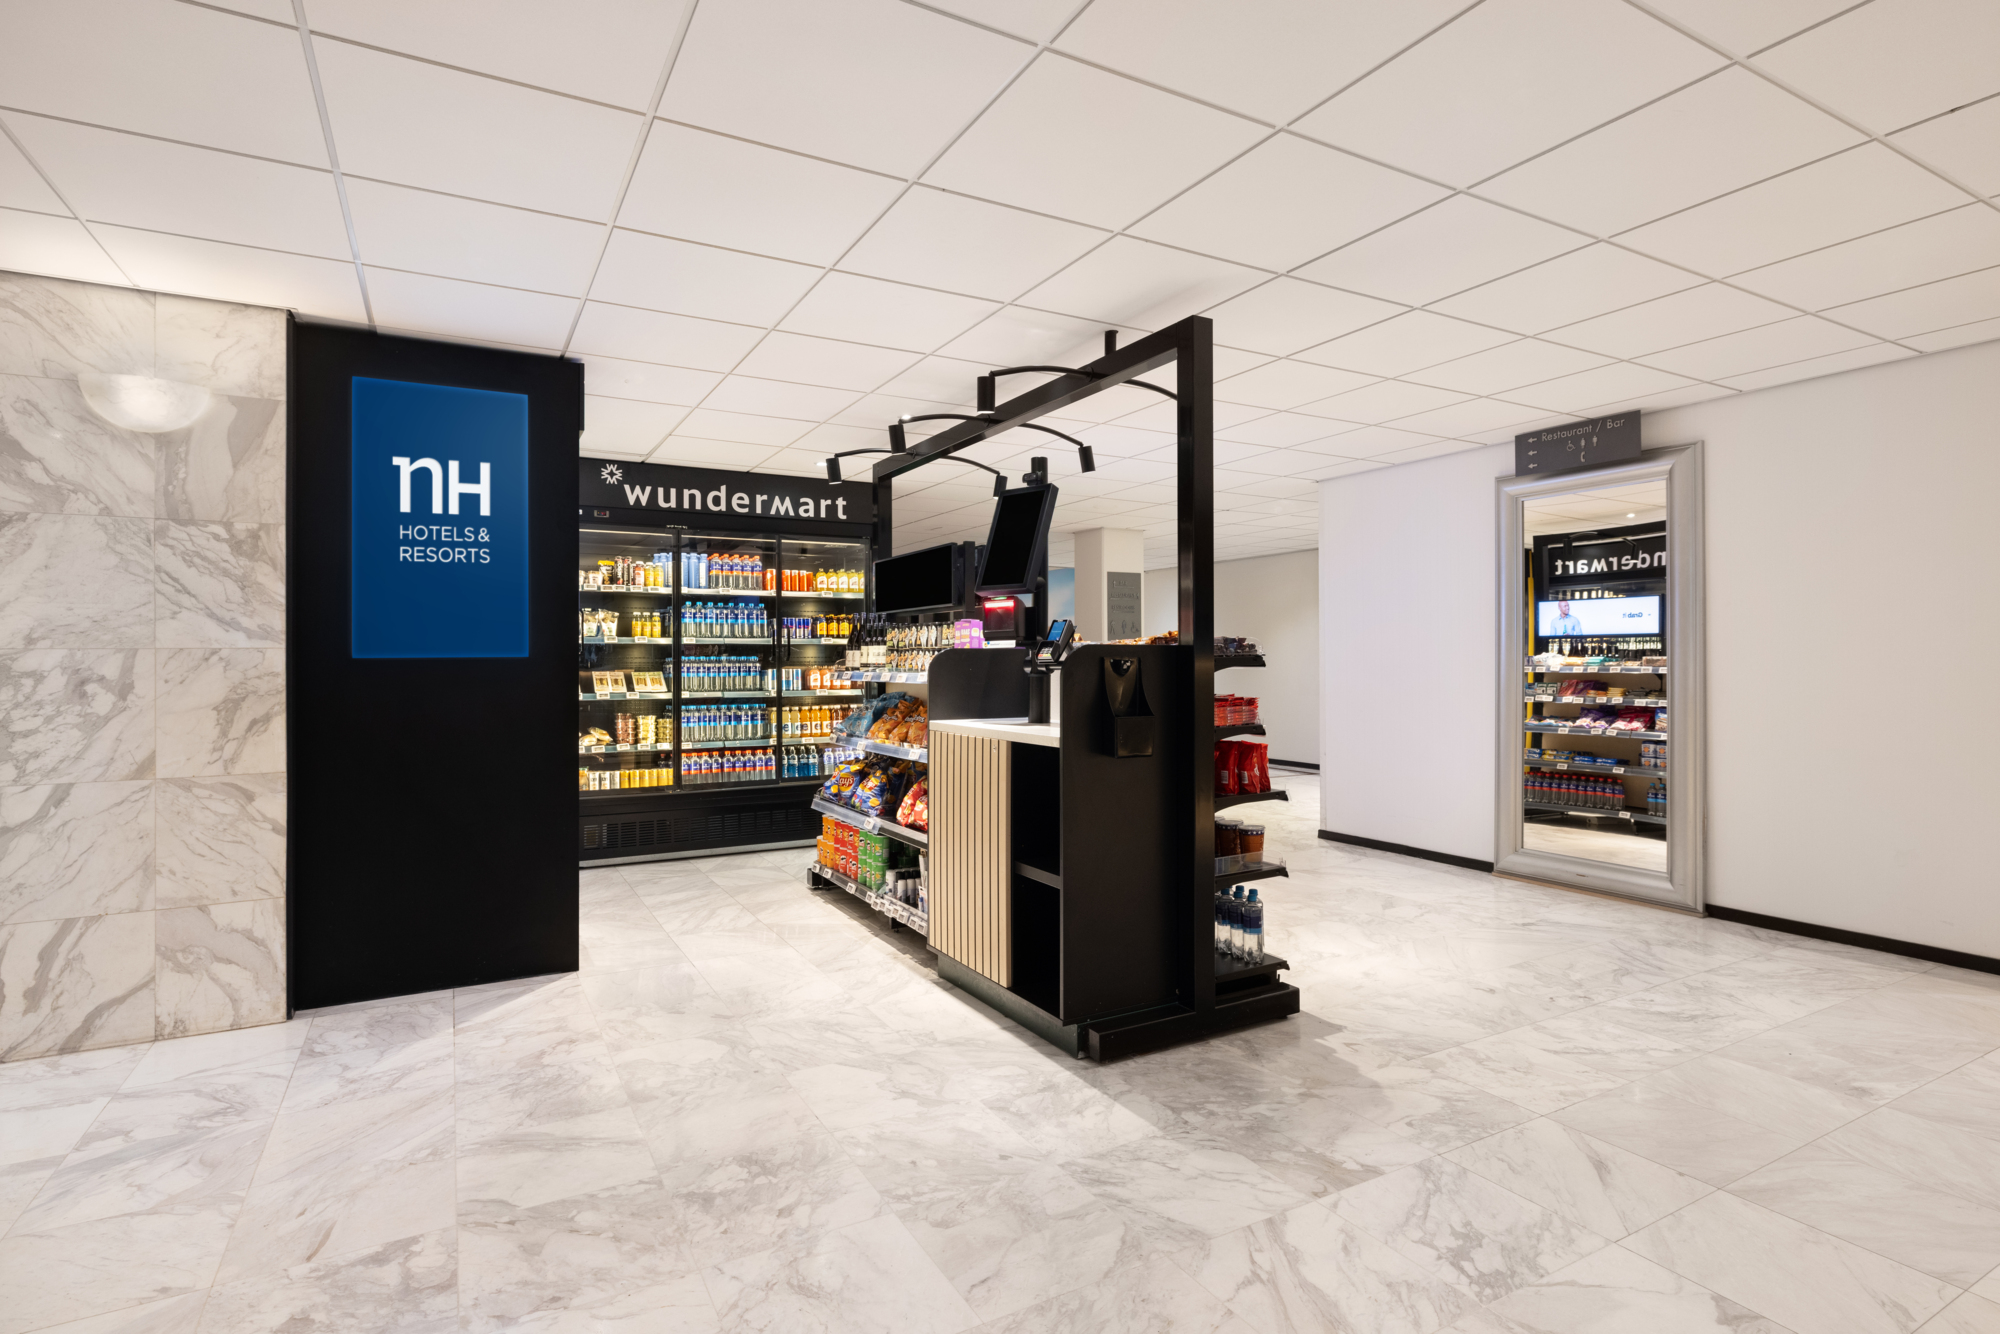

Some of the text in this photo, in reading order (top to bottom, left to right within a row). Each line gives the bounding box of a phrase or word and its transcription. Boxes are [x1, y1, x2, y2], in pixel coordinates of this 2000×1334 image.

[1541, 419, 1625, 442] Restaurant / Bar
[623, 484, 848, 520] wundermart
[399, 524, 490, 542] HOTELS &
[399, 546, 491, 564] RESORTS
